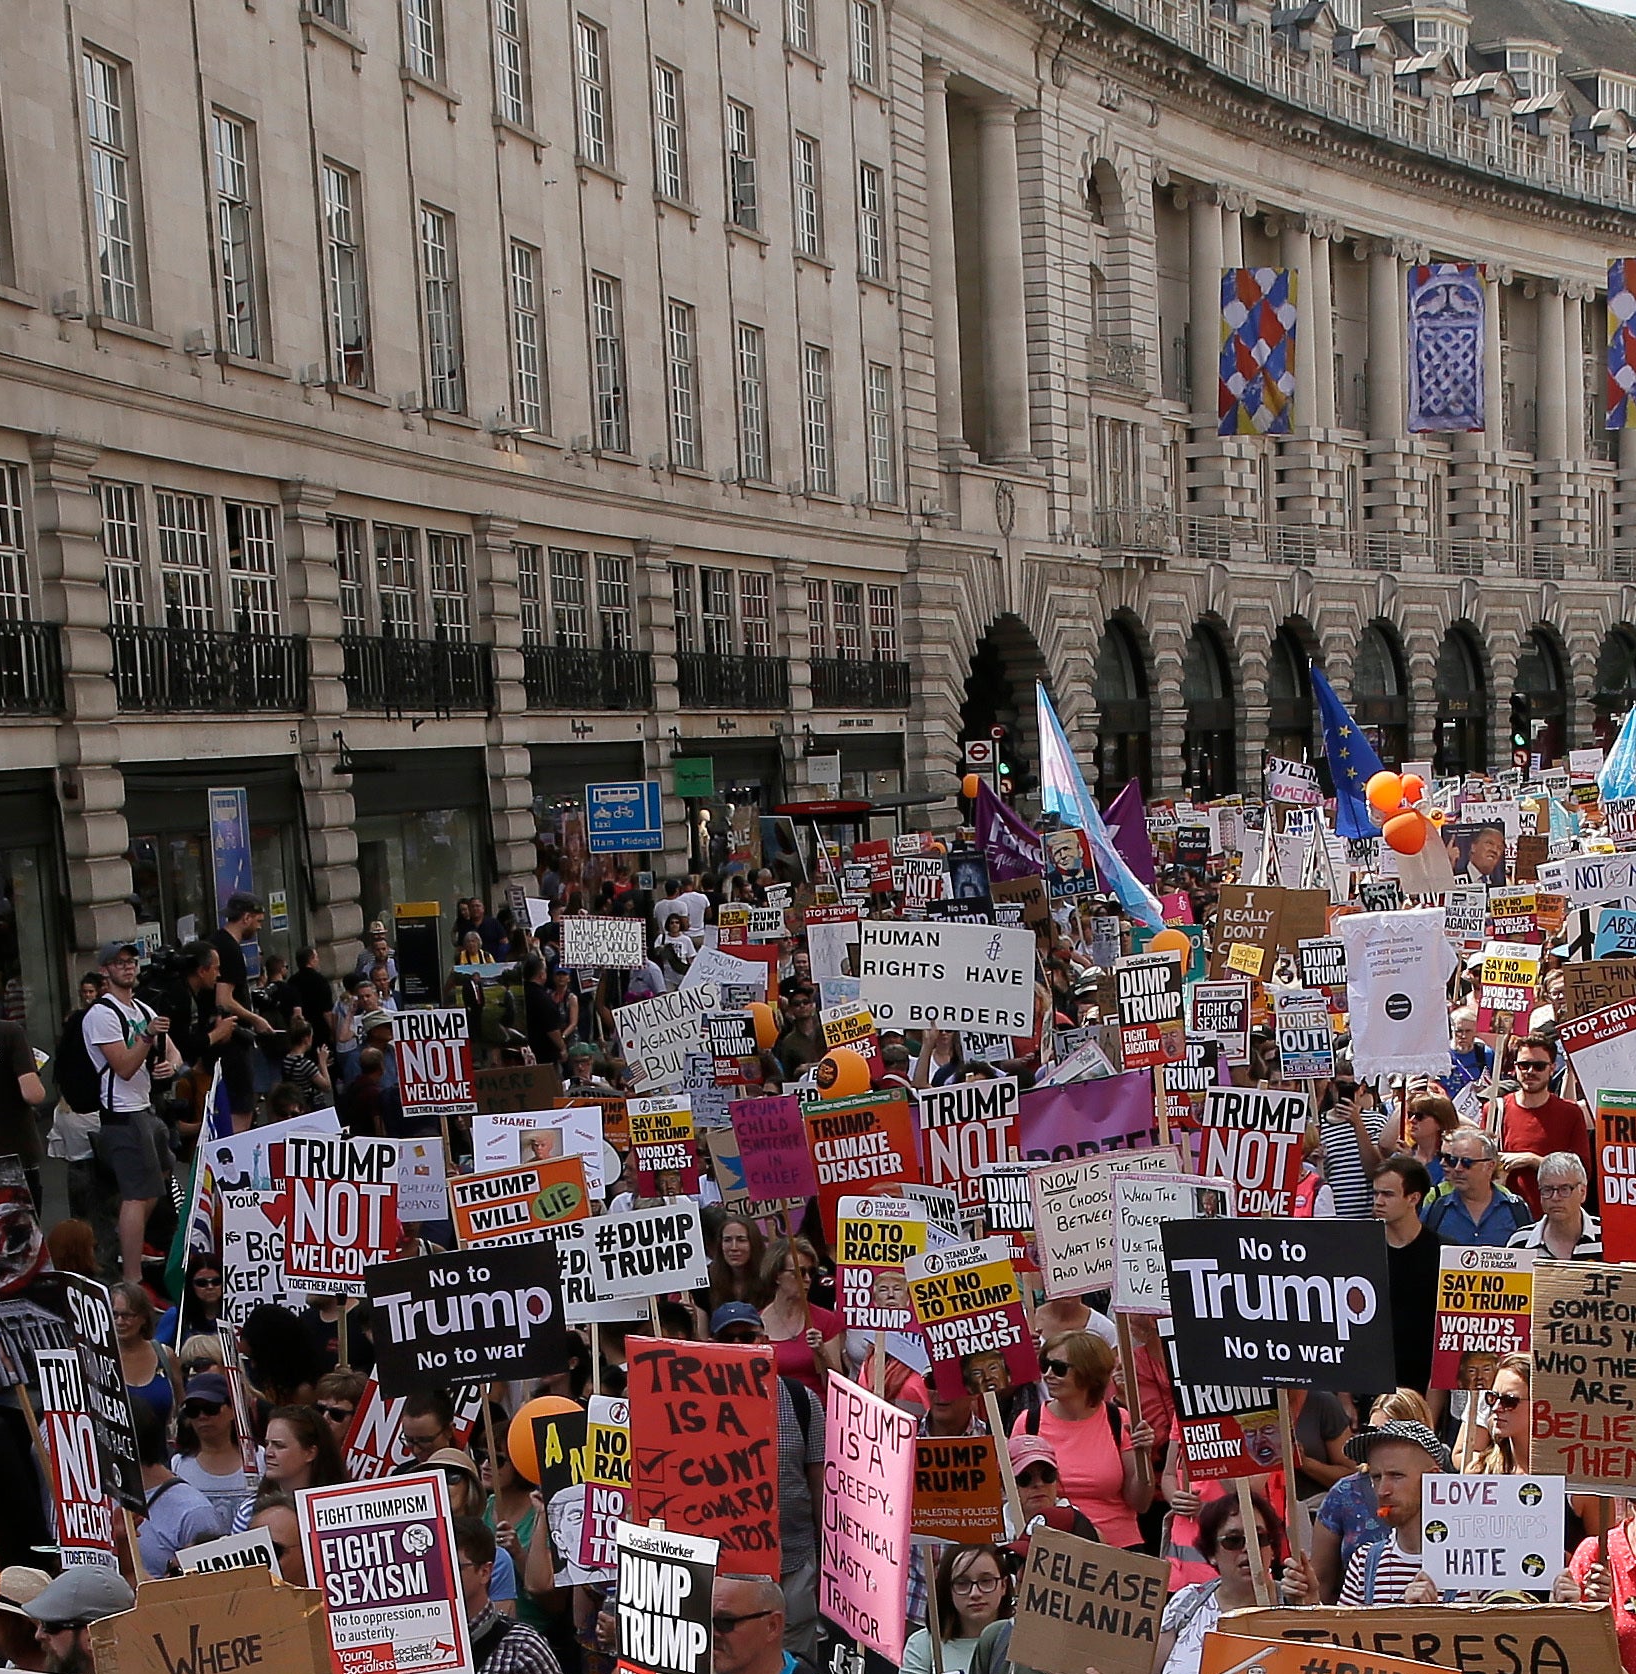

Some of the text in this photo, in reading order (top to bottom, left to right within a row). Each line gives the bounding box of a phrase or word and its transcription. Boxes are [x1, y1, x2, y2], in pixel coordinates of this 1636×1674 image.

[572, 920, 633, 931] WITHOUT
[571, 931, 636, 942] IMMIGRANTS
[864, 930, 940, 947] HUMAN
[864, 960, 1023, 985] RIGHTS HAVE
[1570, 968, 1592, 984] I
[1570, 985, 1615, 1000] THEY
[910, 1005, 1025, 1028] BORDERS
[1582, 1273, 1622, 1298] IF
[1543, 1320, 1613, 1348] TELLS
[1533, 1350, 1588, 1378] WHO
[1570, 1384, 1635, 1411] ARE,
[316, 1495, 427, 1526] FIGHT TRUMPISM
[321, 1530, 395, 1572] FIGHT
[325, 1561, 428, 1607] SEXISM
[333, 1606, 440, 1626] No to oppression, no
[335, 1626, 398, 1642] to austerity.
[337, 1650, 373, 1664] Young
[343, 1660, 394, 1674] Socialists
